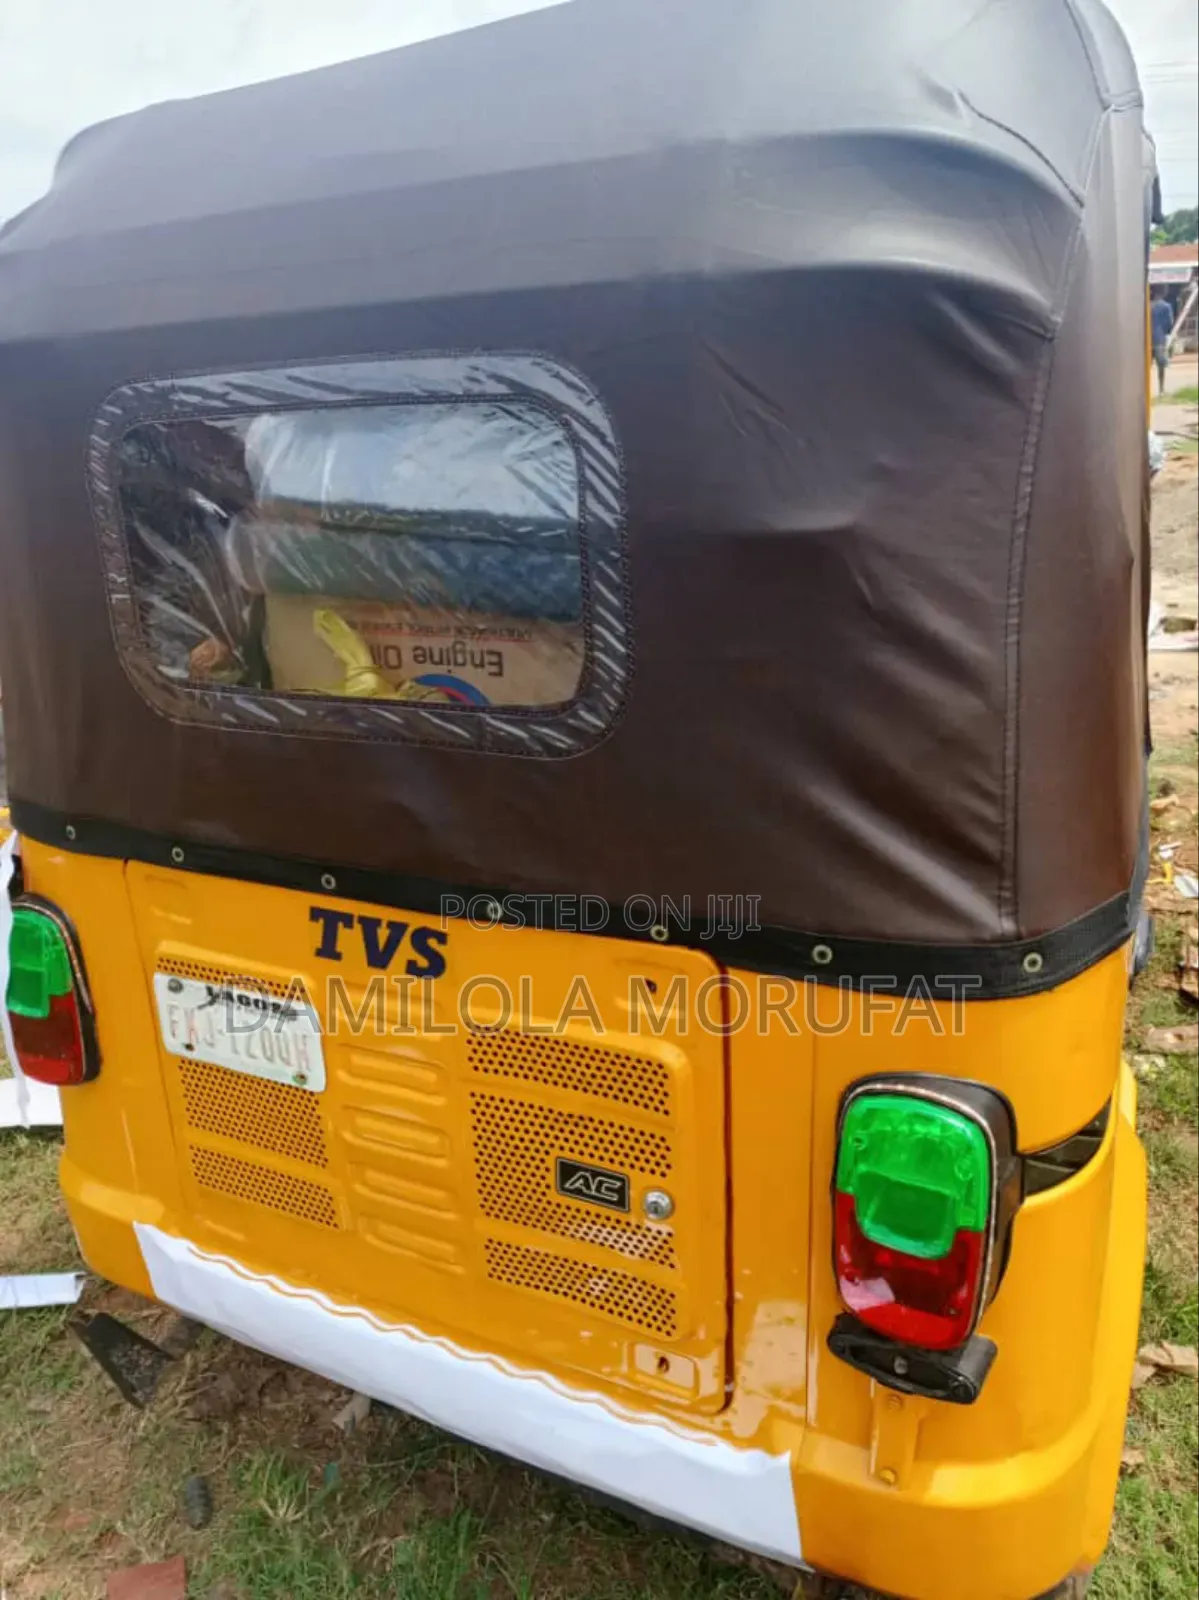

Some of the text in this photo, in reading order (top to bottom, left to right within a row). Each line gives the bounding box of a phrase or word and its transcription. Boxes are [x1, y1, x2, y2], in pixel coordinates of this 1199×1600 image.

[370, 641, 504, 677] Engine Oil
[309, 906, 448, 979] TVS
[564, 1171, 622, 1201] AC
